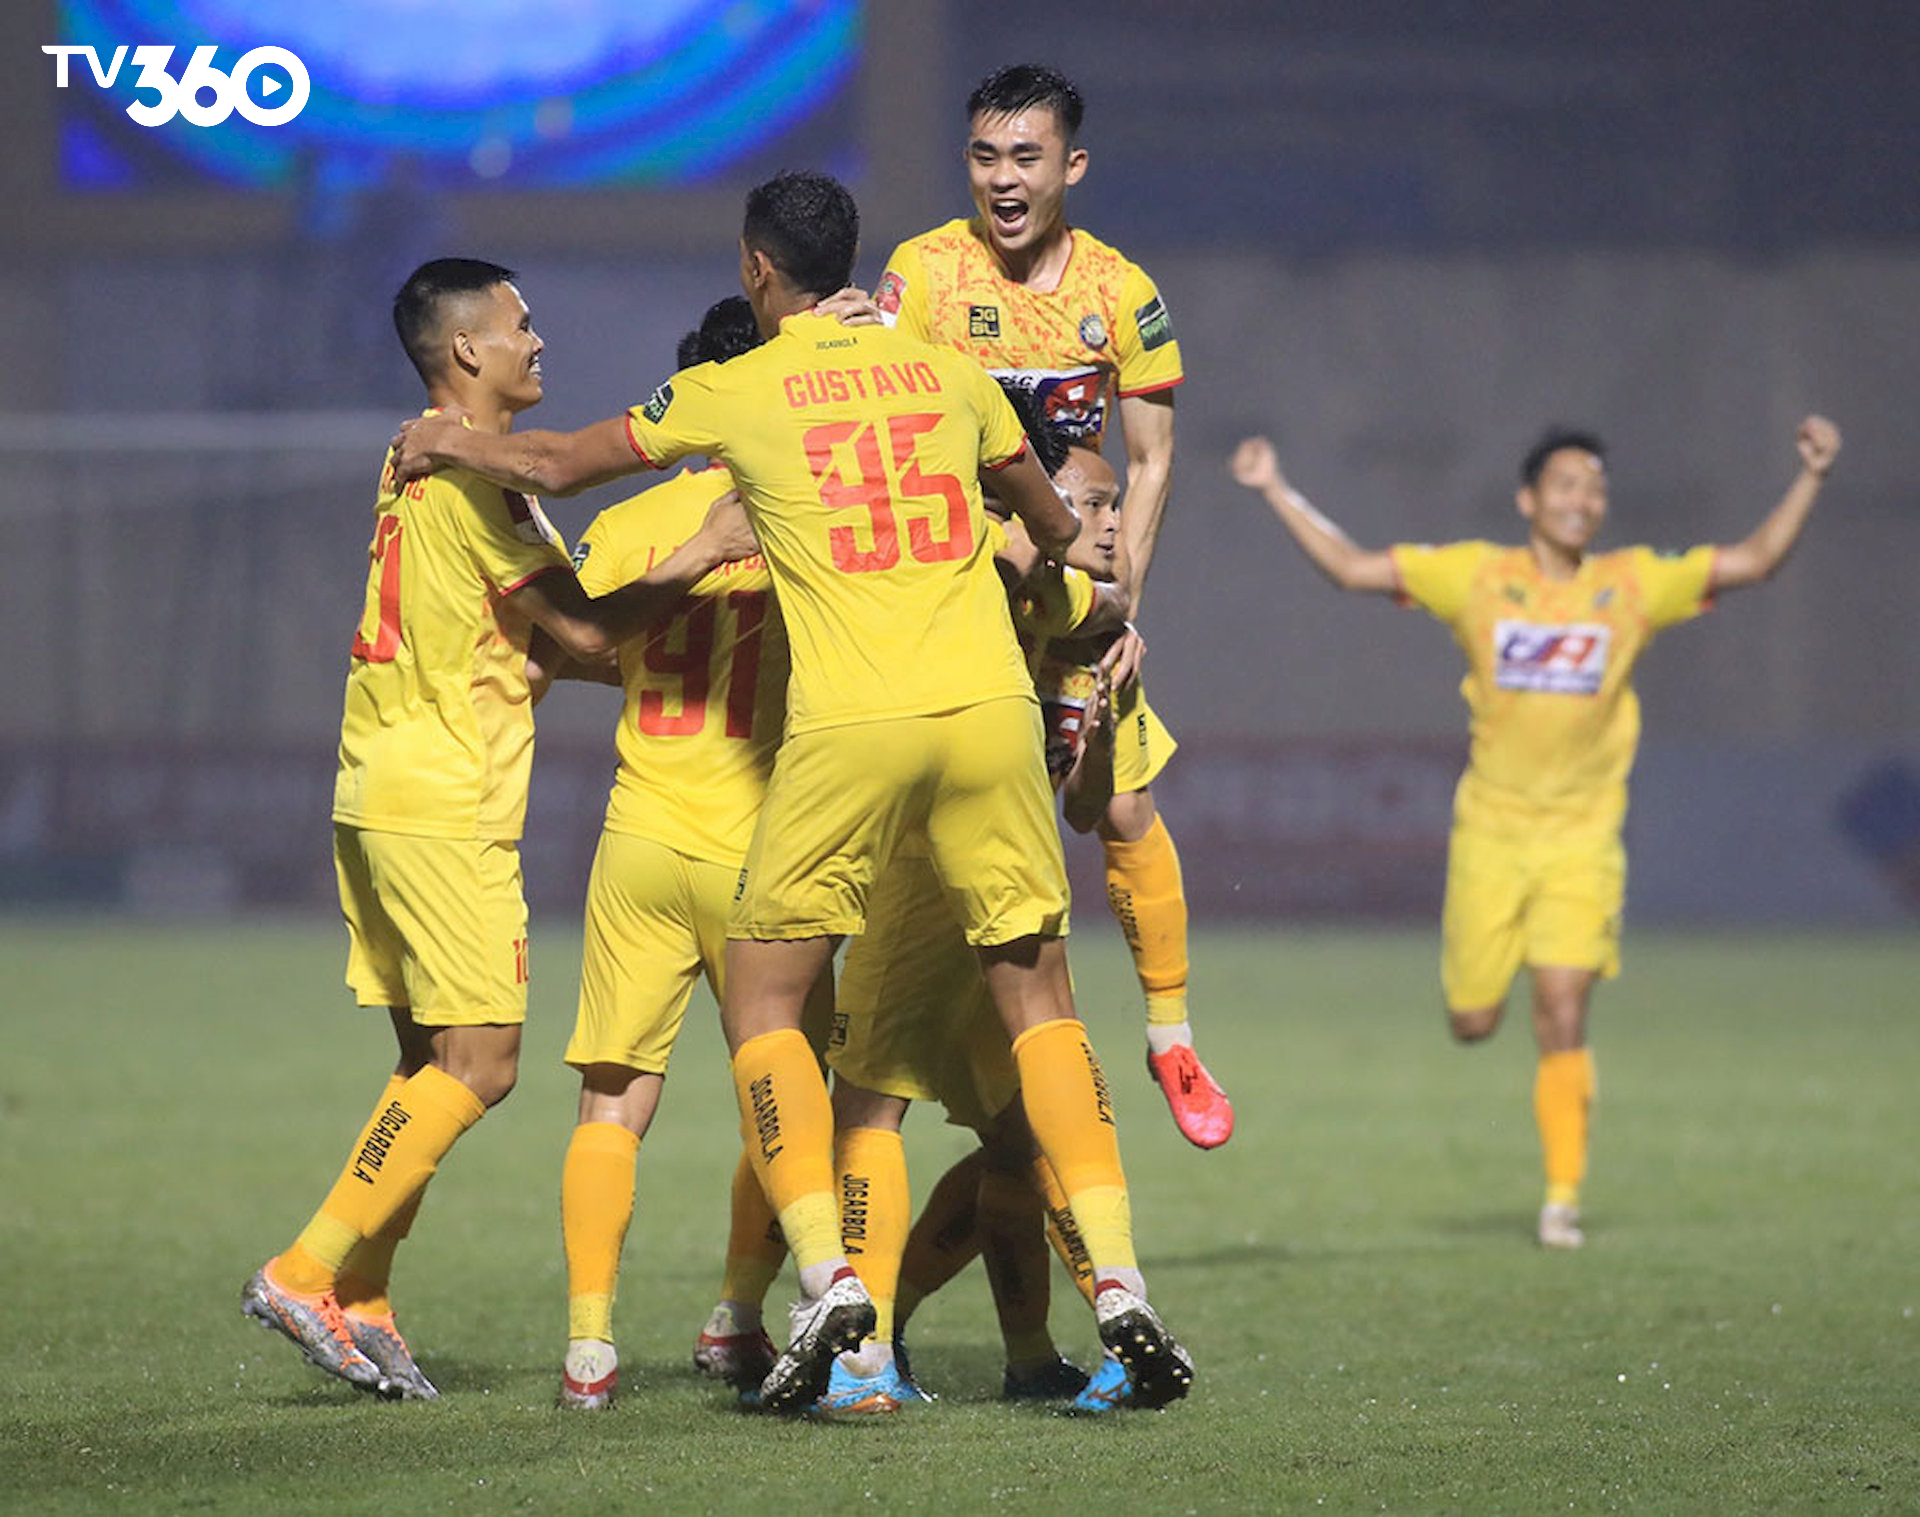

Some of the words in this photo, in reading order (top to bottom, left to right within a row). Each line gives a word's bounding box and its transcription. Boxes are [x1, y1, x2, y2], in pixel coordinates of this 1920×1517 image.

[783, 361, 943, 409] GUSTAVO
[803, 413, 975, 574] 95
[637, 589, 769, 739] 91
[352, 1100, 412, 1185] JOGARBOLA
[750, 1073, 784, 1165] JOGARBOLA
[842, 1173, 869, 1255] JOGARBOLA
